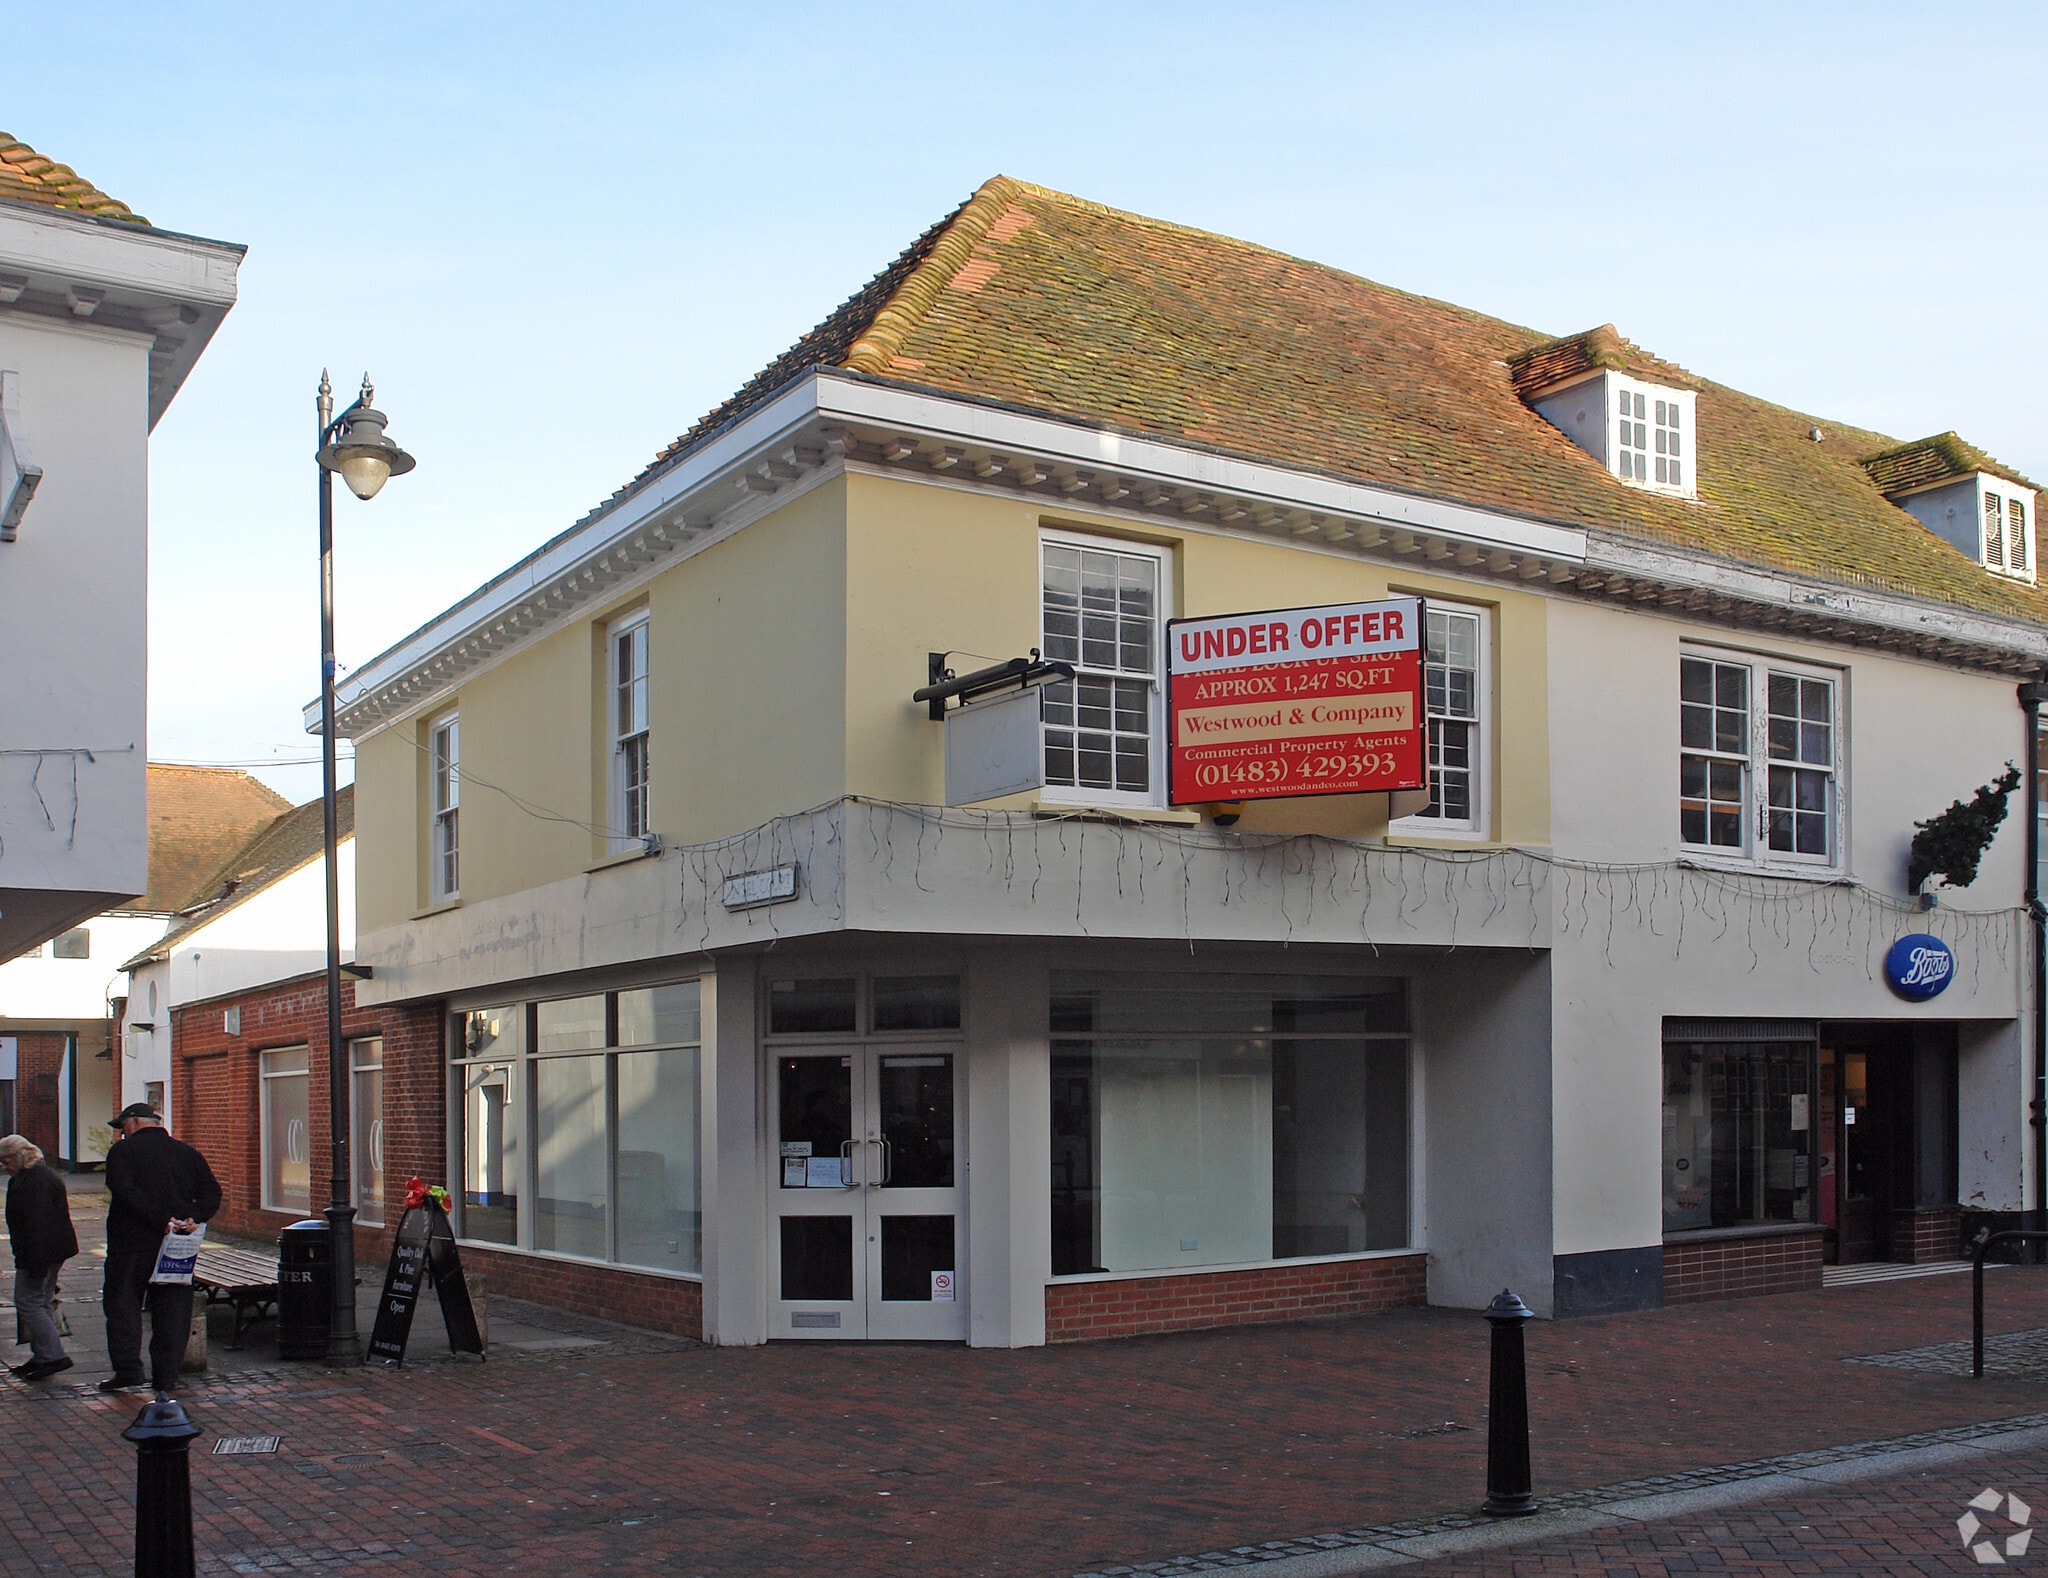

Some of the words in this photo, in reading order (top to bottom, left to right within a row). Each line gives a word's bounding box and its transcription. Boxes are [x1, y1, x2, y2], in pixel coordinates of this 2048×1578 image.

[1181, 622, 1289, 662] UNDER
[1300, 610, 1404, 649] OFFER
[1194, 676, 1277, 700] APPROX
[1284, 673, 1329, 695] 1,247
[1335, 667, 1394, 689] SQ.FT
[1185, 709, 1282, 734] Westwood
[1288, 707, 1305, 725] &
[1311, 705, 1406, 725] Company
[1184, 743, 1273, 761] Commercial
[1280, 740, 1347, 754] Property
[1354, 736, 1407, 750] Agents
[1195, 758, 1288, 787] (01483)
[1295, 752, 1396, 778] 429393
[1231, 780, 1359, 795] www.westwoodandco.com
[1901, 947, 1950, 986] Boots
